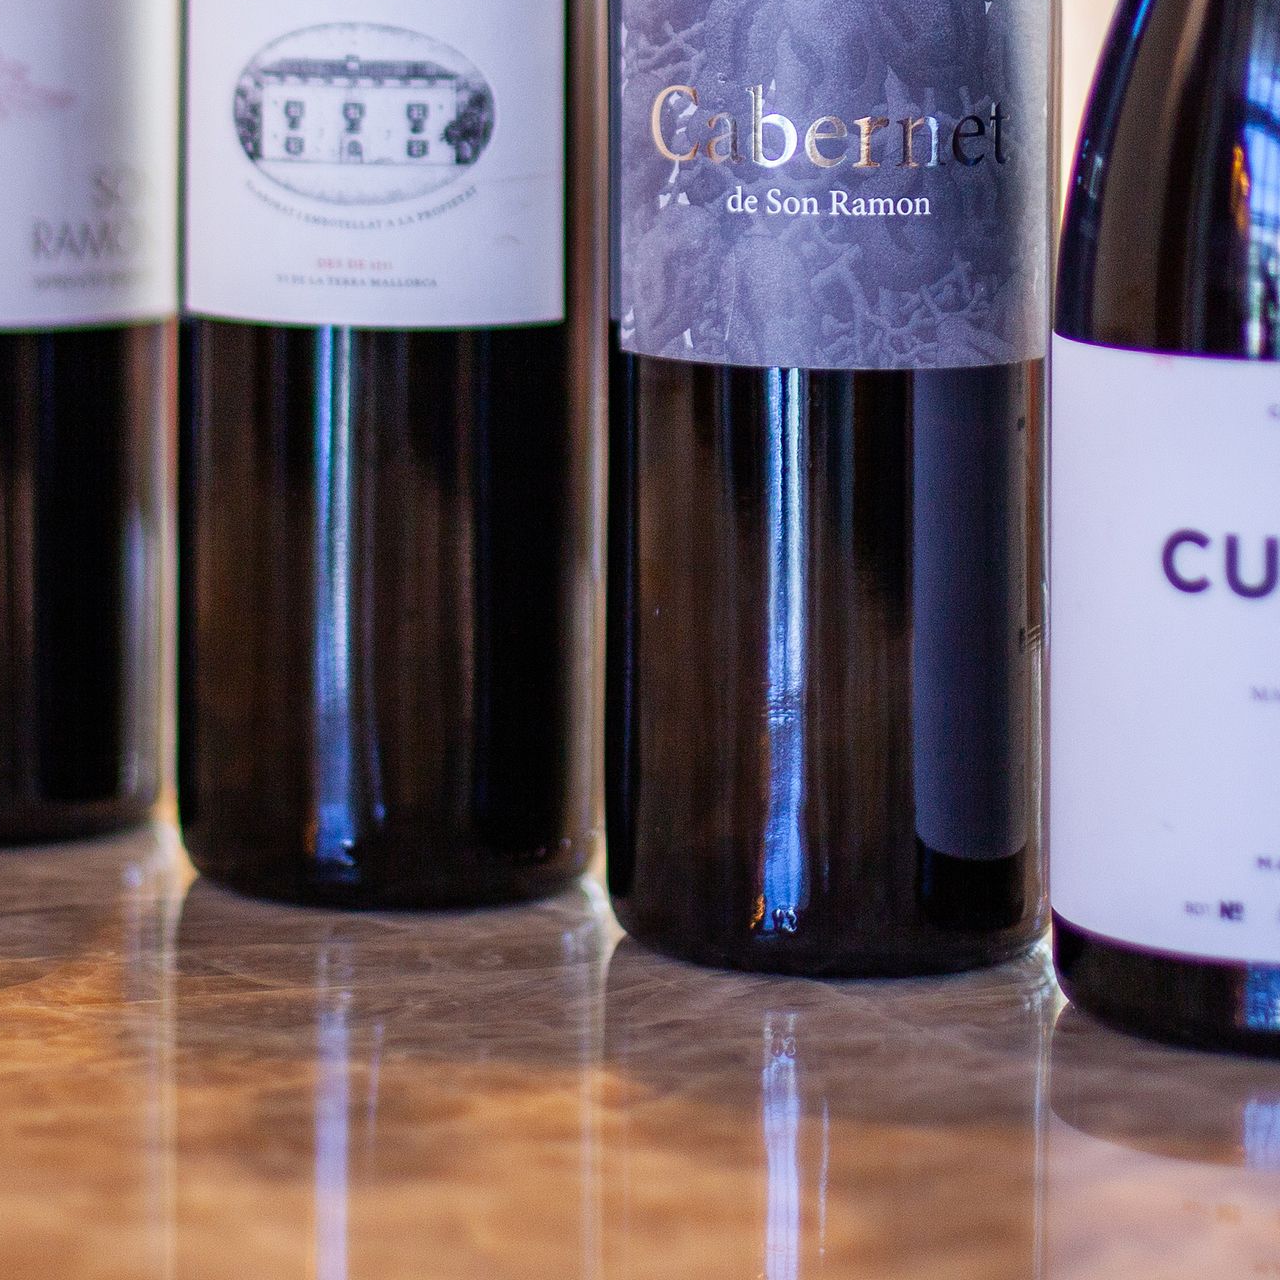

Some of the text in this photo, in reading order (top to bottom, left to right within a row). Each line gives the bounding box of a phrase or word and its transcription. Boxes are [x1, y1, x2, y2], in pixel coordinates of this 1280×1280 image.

[650, 83, 1011, 169] Cabernet
[726, 186, 932, 217] de Son Ramon
